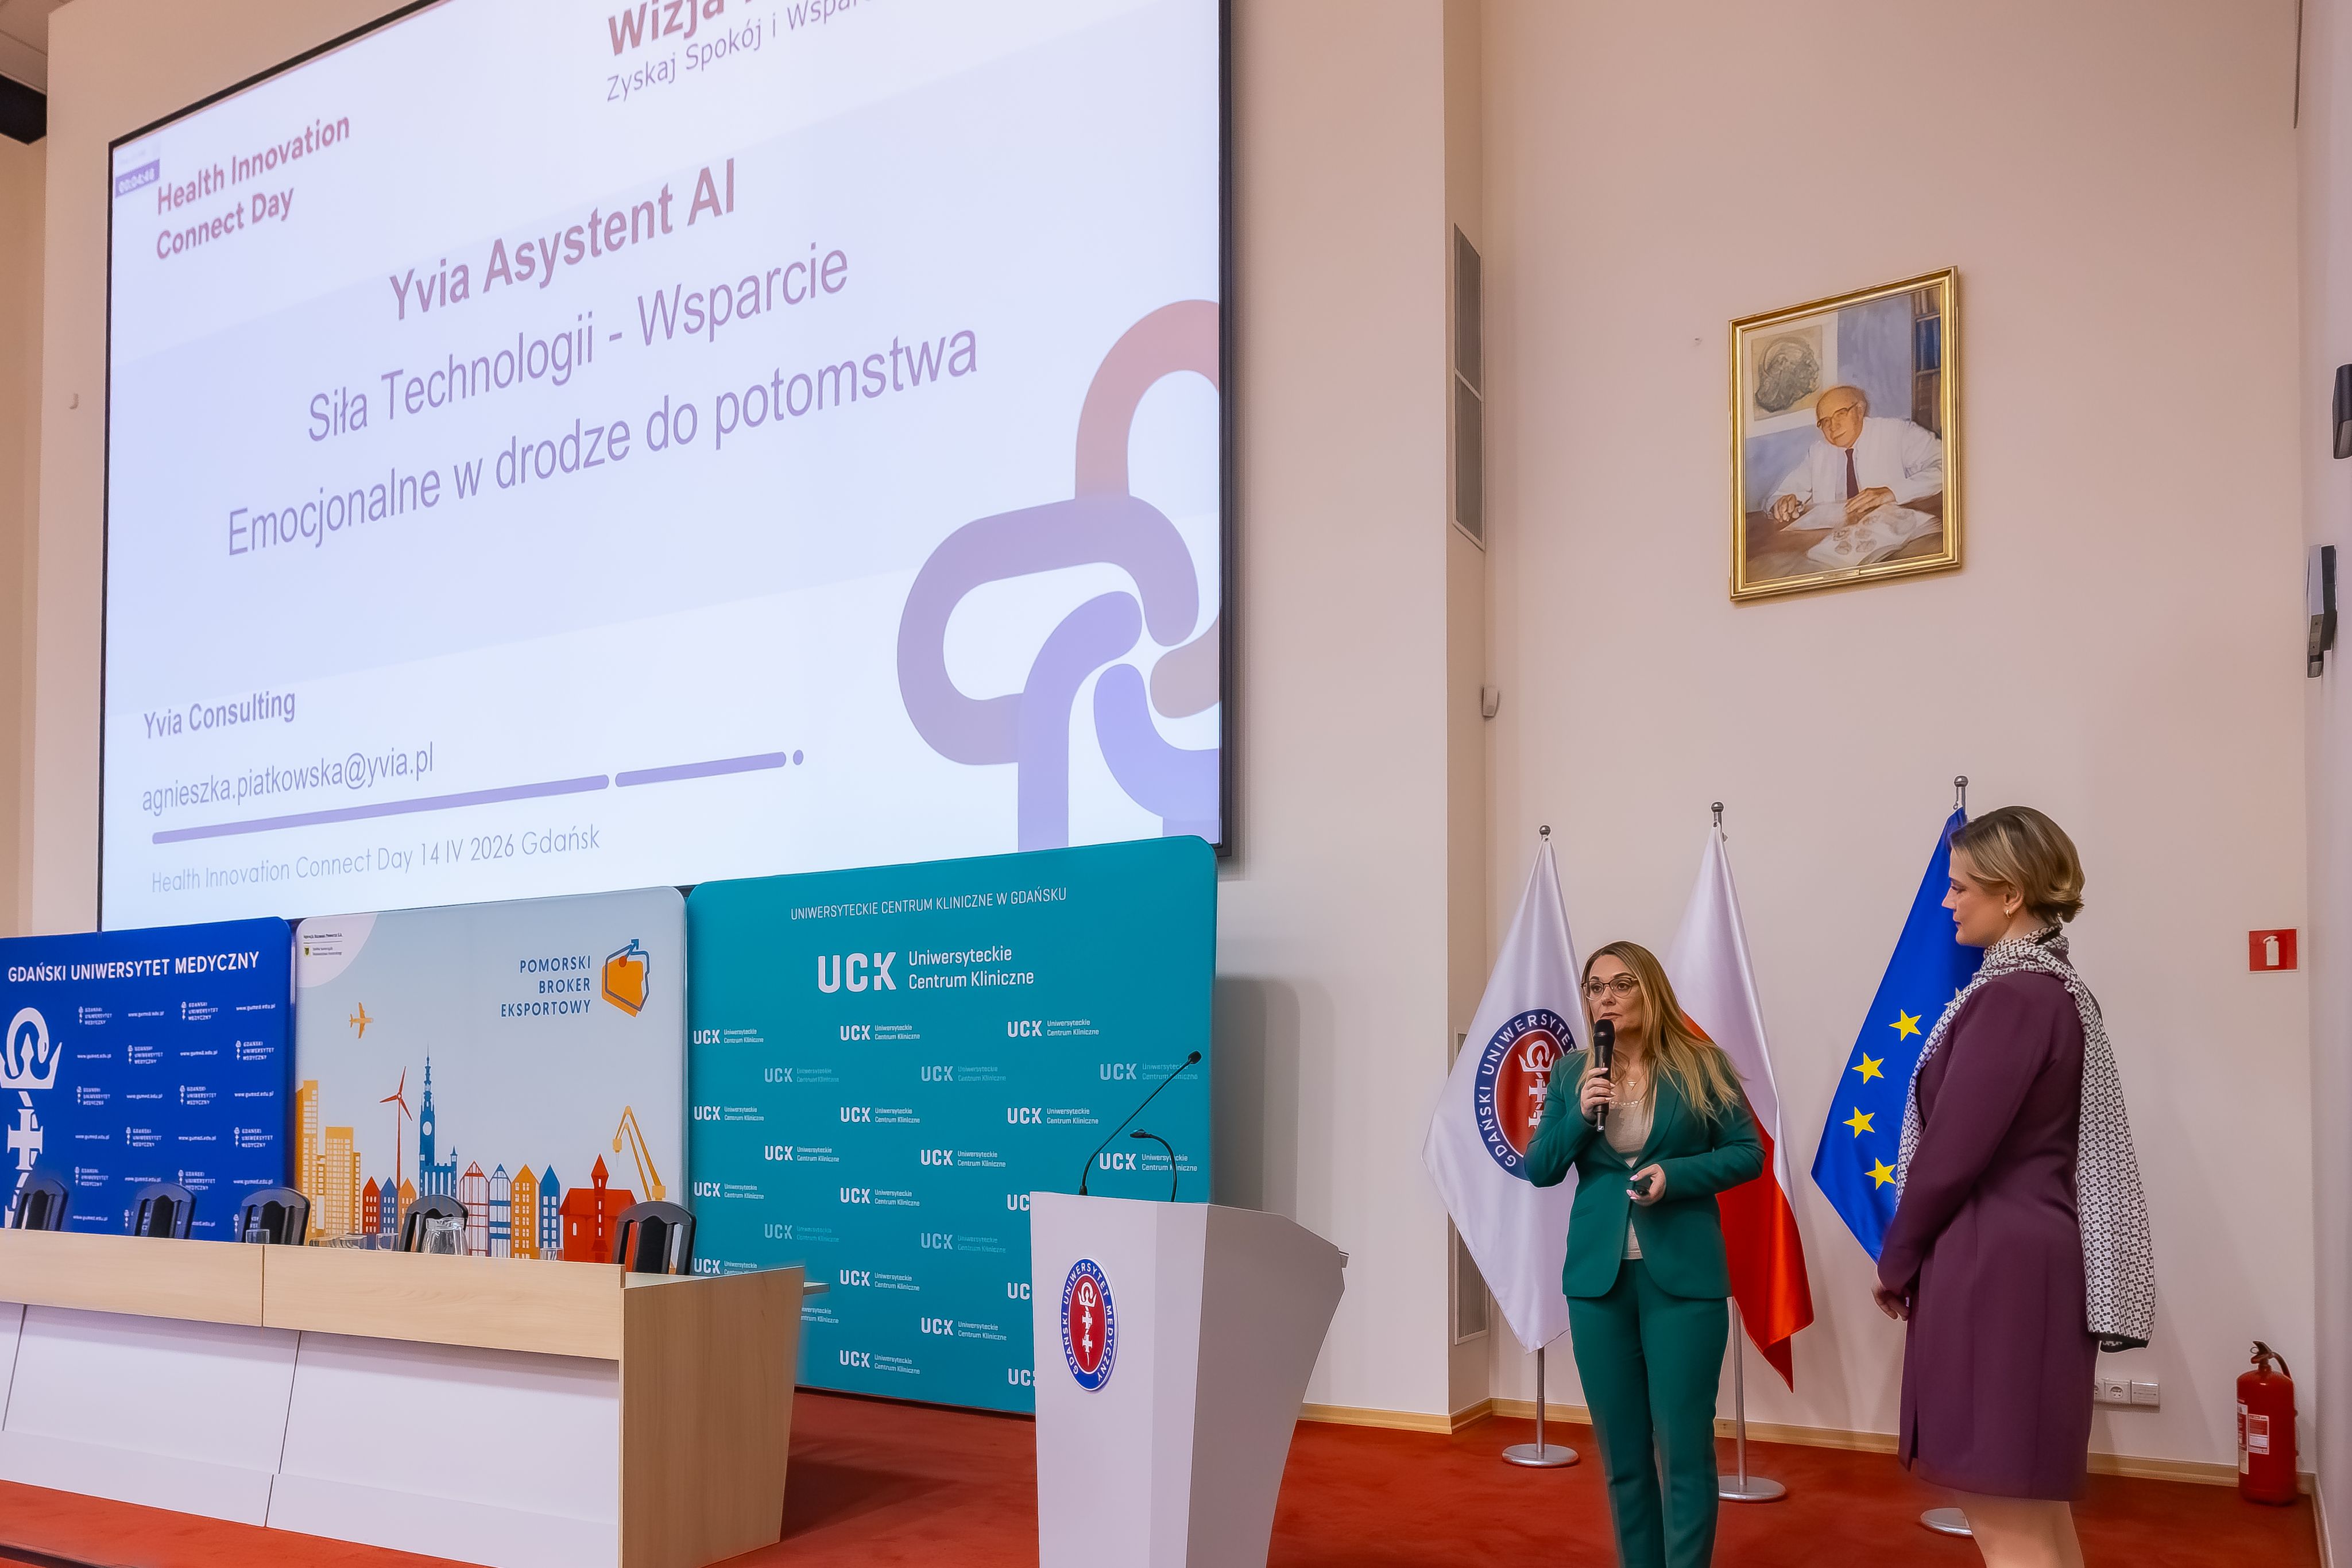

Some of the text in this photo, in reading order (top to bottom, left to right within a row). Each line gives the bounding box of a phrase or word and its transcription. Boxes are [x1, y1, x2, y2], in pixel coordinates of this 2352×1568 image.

[608, 0, 724, 56] Wizja
[607, 0, 869, 102] Zyskaj Spokój i Wspa
[157, 117, 350, 216] Health Innovation
[157, 187, 294, 260] Connect Day
[389, 157, 734, 320] Yvia Asystent AI
[308, 387, 368, 442] Siła
[381, 311, 593, 420] Technologii
[638, 242, 848, 346] Wsparcie
[229, 330, 977, 556] Emocjonalne w drodze do potomstwa
[144, 691, 296, 739] Yvia Consulting
[142, 741, 433, 816] agnieszka.piatkowska@yvia.pl
[152, 823, 600, 893] Health Innovation Connect Day 14 IV 2026 Gdańsk
[790, 885, 1067, 920] UNIWERSYTECKIE CENTRUM KLINICZNE W GDAŃSKU
[8, 951, 260, 982] GDAŃSKI UNIWERSYTET MEDYCZNY
[520, 955, 590, 973] POMORSKI
[817, 946, 1012, 993] UCK Uniwersyteckie
[539, 978, 590, 993] BROKER
[908, 969, 1034, 989] Centrum Kliniczne
[501, 1000, 590, 1017] EKSPORTOWY
[694, 1029, 720, 1044] UCK
[841, 1025, 870, 1040] UCK
[1008, 1019, 1090, 1037] UCK Uniwersyteckie
[765, 1068, 792, 1082] UCK
[922, 1066, 953, 1081] UCK
[1100, 1063, 1136, 1080] UCK
[1479, 1013, 1577, 1167] GDAŃSKI UNIWERSYTET
[694, 1106, 720, 1120] UCK
[841, 1107, 871, 1122] UCK
[1008, 1108, 1042, 1124] UCK
[765, 1146, 793, 1160] UCK
[921, 1149, 953, 1166] UCK
[1100, 1153, 1189, 1170] UCK Uniwersyckie
[694, 1182, 720, 1197] UCK
[841, 1188, 870, 1203] UCK
[1007, 1194, 1030, 1211] UC
[765, 1224, 792, 1239] UCK
[921, 1233, 953, 1249] UCK
[694, 1258, 721, 1275] UCK
[840, 1269, 870, 1286] UCK
[1007, 1282, 1030, 1300] UC
[922, 1318, 998, 1335] UCK Uniwersyteckie
[1062, 1263, 1113, 1382] GDAŃSKI UNIWERSYTET MEDYCZNY
[840, 1350, 870, 1368] UCK
[1008, 1368, 1035, 1387] UC
